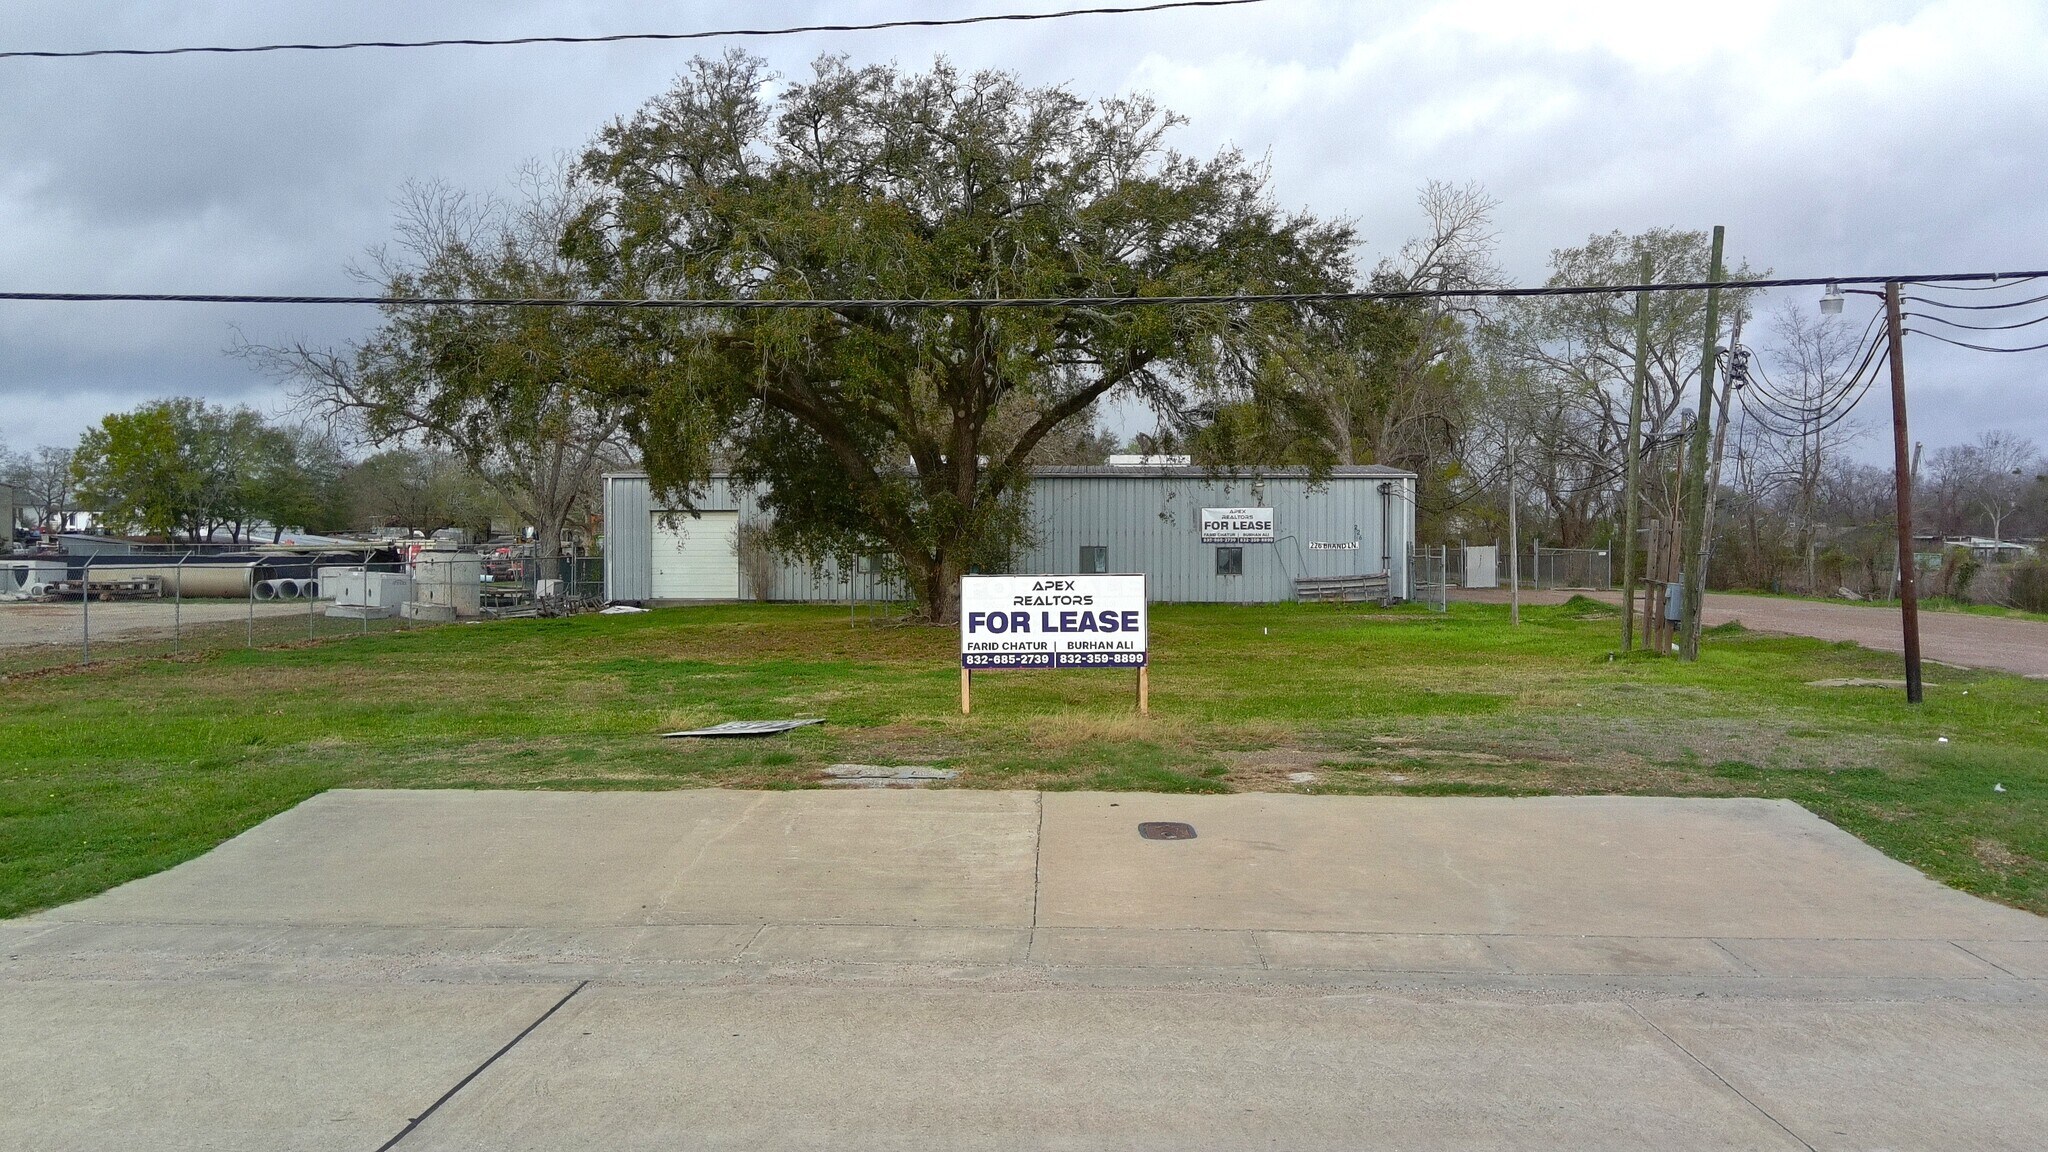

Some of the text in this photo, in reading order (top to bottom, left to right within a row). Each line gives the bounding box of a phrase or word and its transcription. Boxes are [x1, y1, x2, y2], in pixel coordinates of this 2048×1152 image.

[1204, 521, 1271, 530] FOR LEASE
[1310, 541, 1322, 549] 226
[1032, 580, 1075, 591] APEX
[1013, 595, 1094, 606] REALTORS
[968, 610, 1139, 634] FOR LEASE
[967, 641, 1048, 651] FARID CHATUR
[1067, 640, 1134, 650] BURHAN ALI
[966, 654, 1049, 665] 832-685-2739
[1059, 653, 1144, 664] 832-359-8899
